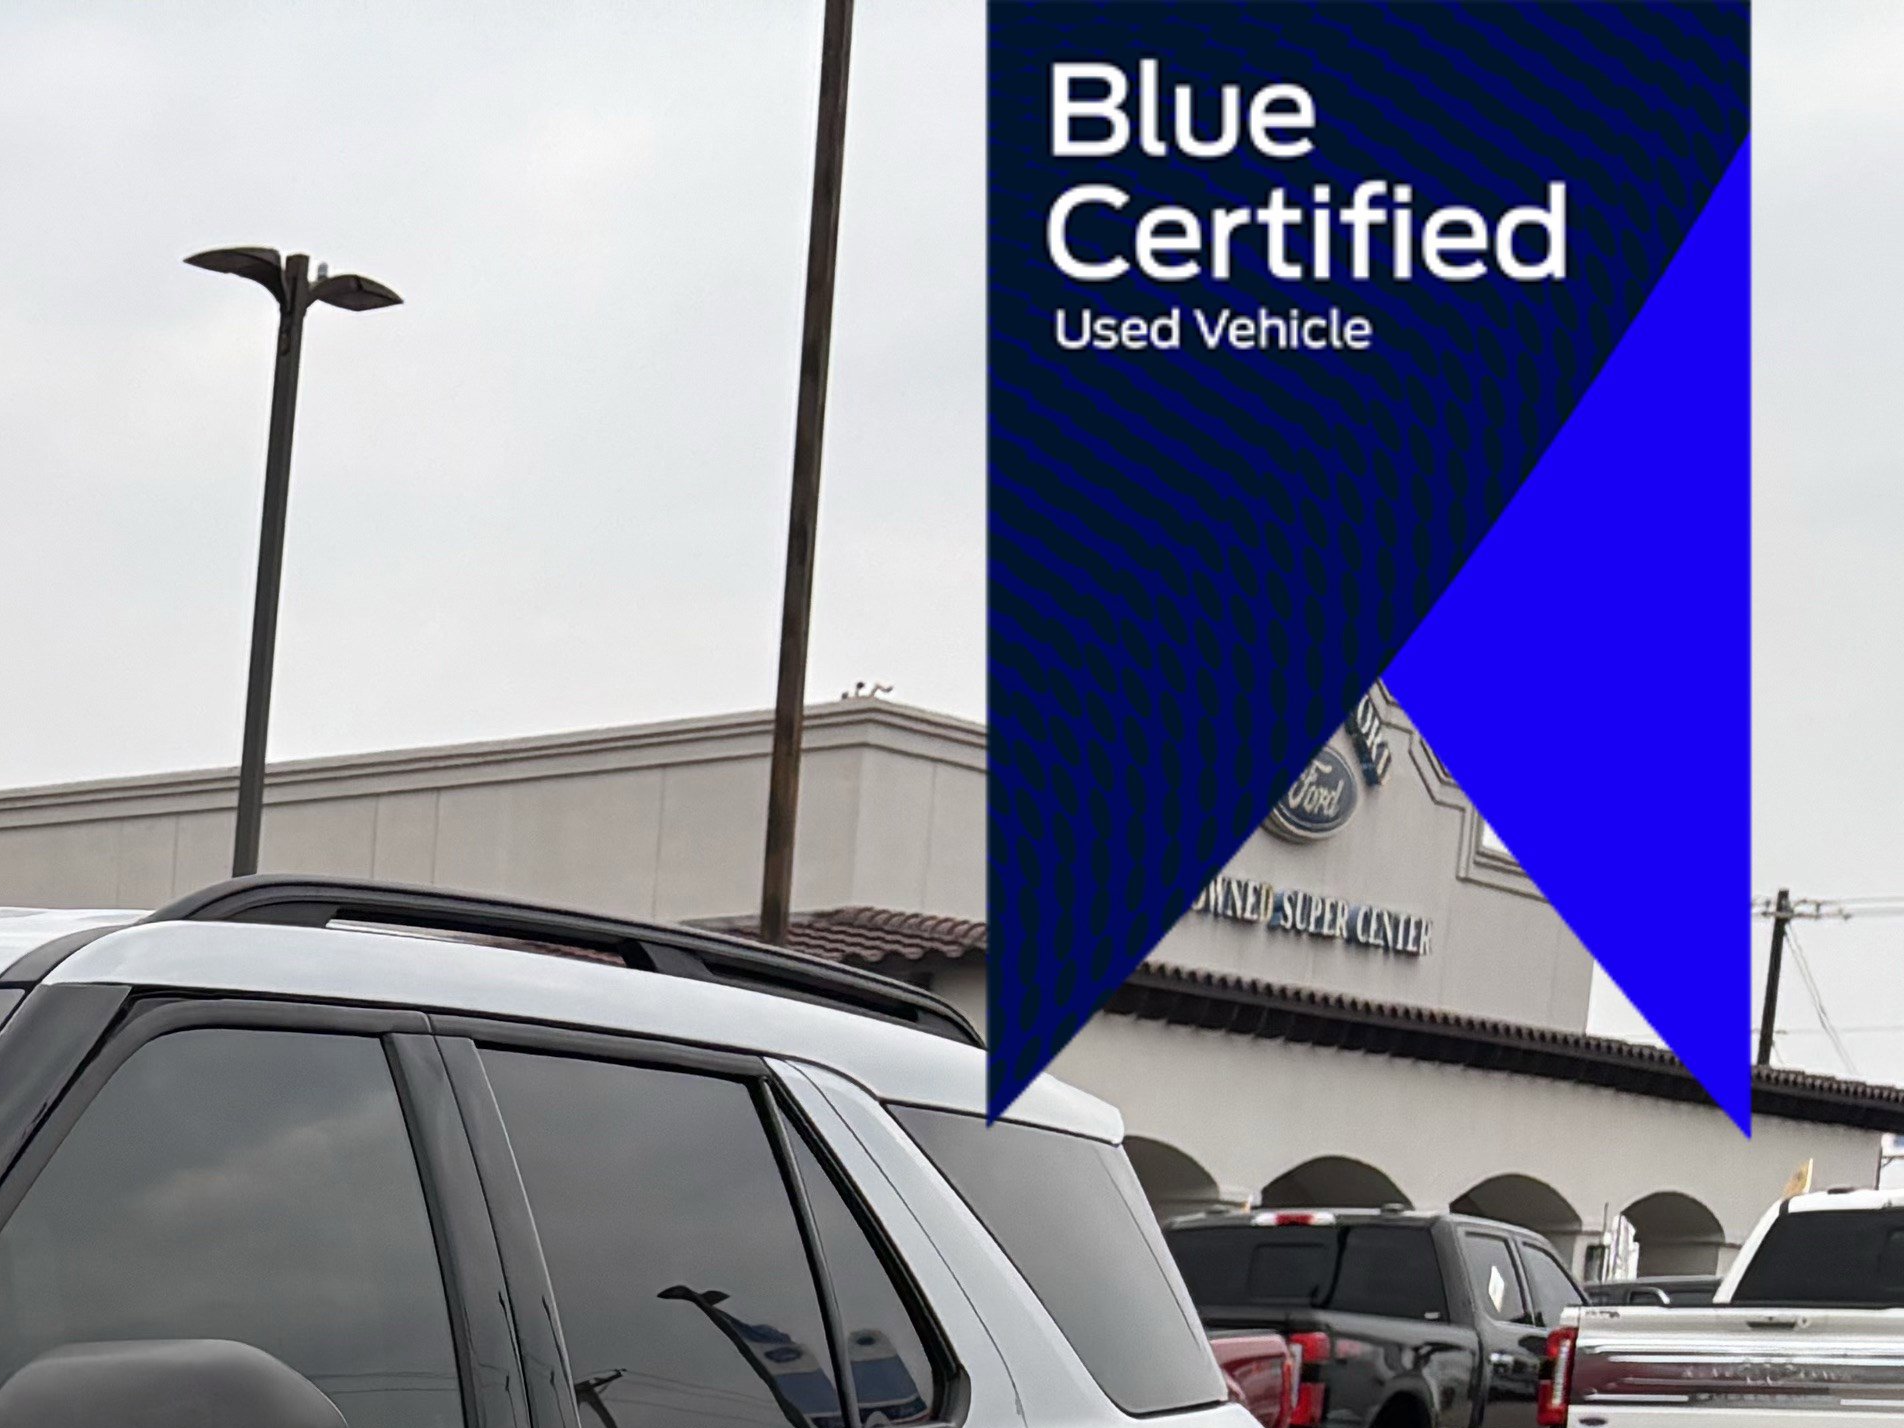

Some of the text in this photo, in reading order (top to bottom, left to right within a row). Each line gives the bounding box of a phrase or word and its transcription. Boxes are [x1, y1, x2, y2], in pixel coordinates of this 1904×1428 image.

[1288, 760, 1344, 818] Ford
[1280, 890, 1350, 939] SUPER
[1355, 904, 1433, 956] CENTER
